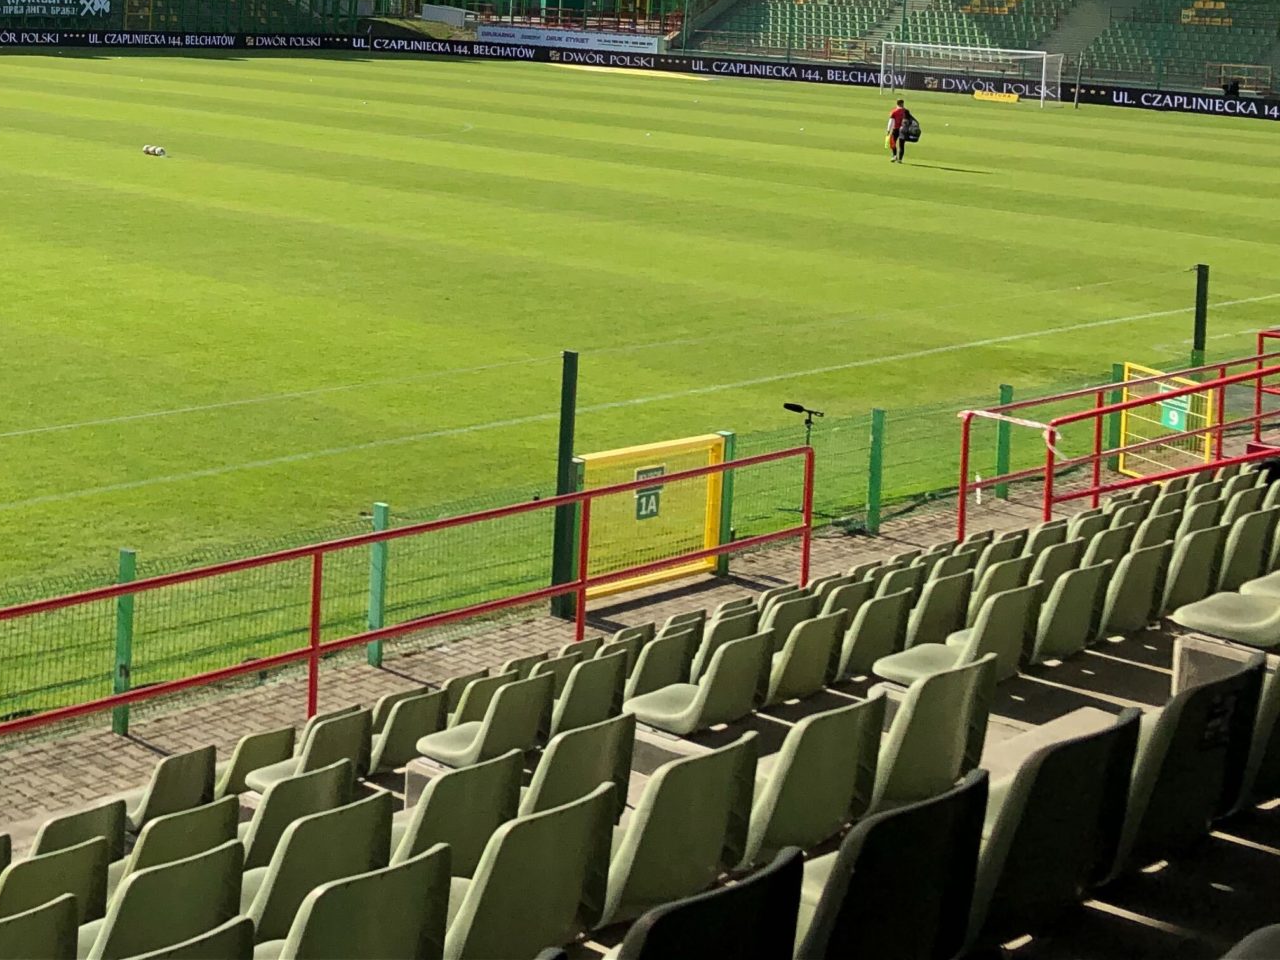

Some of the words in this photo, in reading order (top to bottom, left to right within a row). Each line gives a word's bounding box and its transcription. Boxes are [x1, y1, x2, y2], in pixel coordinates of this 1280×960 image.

[21, 33, 59, 44] POLSKI
[88, 33, 103, 44] UL.
[104, 33, 166, 45] CZAPLINIECKA
[168, 36, 184, 47] 144,
[185, 33, 236, 46] BEŁCHATÓW
[255, 35, 287, 47] DWÓR
[289, 37, 321, 47] POLSKI
[352, 38, 370, 48] UL.
[373, 39, 451, 53] CZAPLINIECKA
[473, 44, 536, 59] BEŁCHATÓW
[562, 51, 606, 65] DWÓR
[609, 55, 655, 68] POLSKI
[691, 59, 709, 72] UL.
[712, 61, 797, 79] CZAPLINIECKA
[826, 69, 906, 86] BEŁCHATÓW
[942, 78, 995, 93] DWÓR
[1003, 82, 1062, 99] POLSKI
[1112, 91, 1136, 105] UL.
[1141, 92, 1258, 115] CZAPLINIECKA
[1168, 410, 1180, 426] 9
[639, 495, 658, 516] 1A
